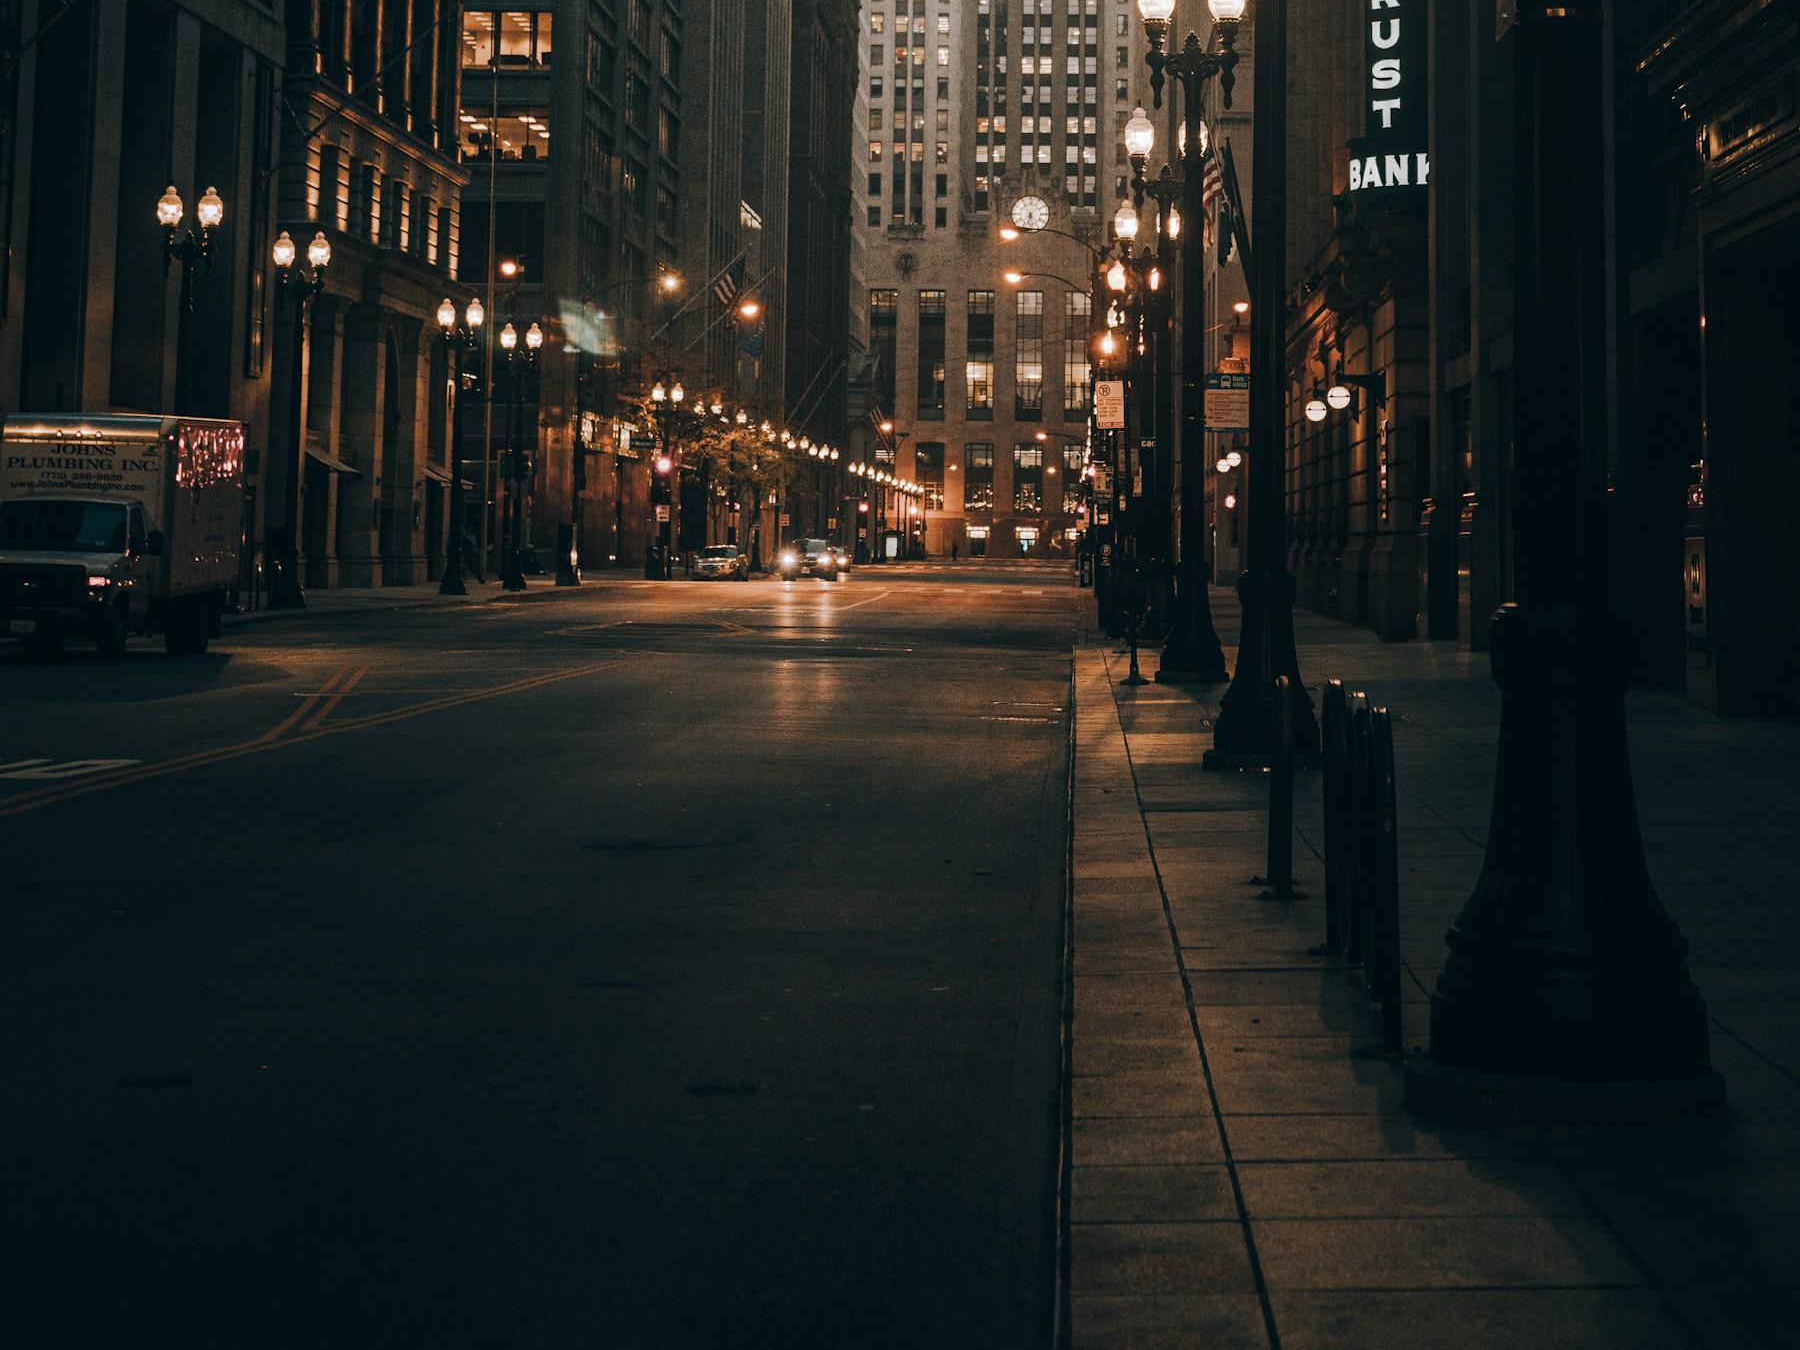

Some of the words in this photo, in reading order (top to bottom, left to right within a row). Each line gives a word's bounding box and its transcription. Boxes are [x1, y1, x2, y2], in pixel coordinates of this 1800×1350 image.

[1349, 152, 1431, 192] BANK
[1232, 381, 1247, 389] stop
[51, 444, 115, 455] JOHNS
[7, 456, 112, 470] PLUMBING
[120, 459, 160, 472] INC.
[40, 471, 68, 481] (773)
